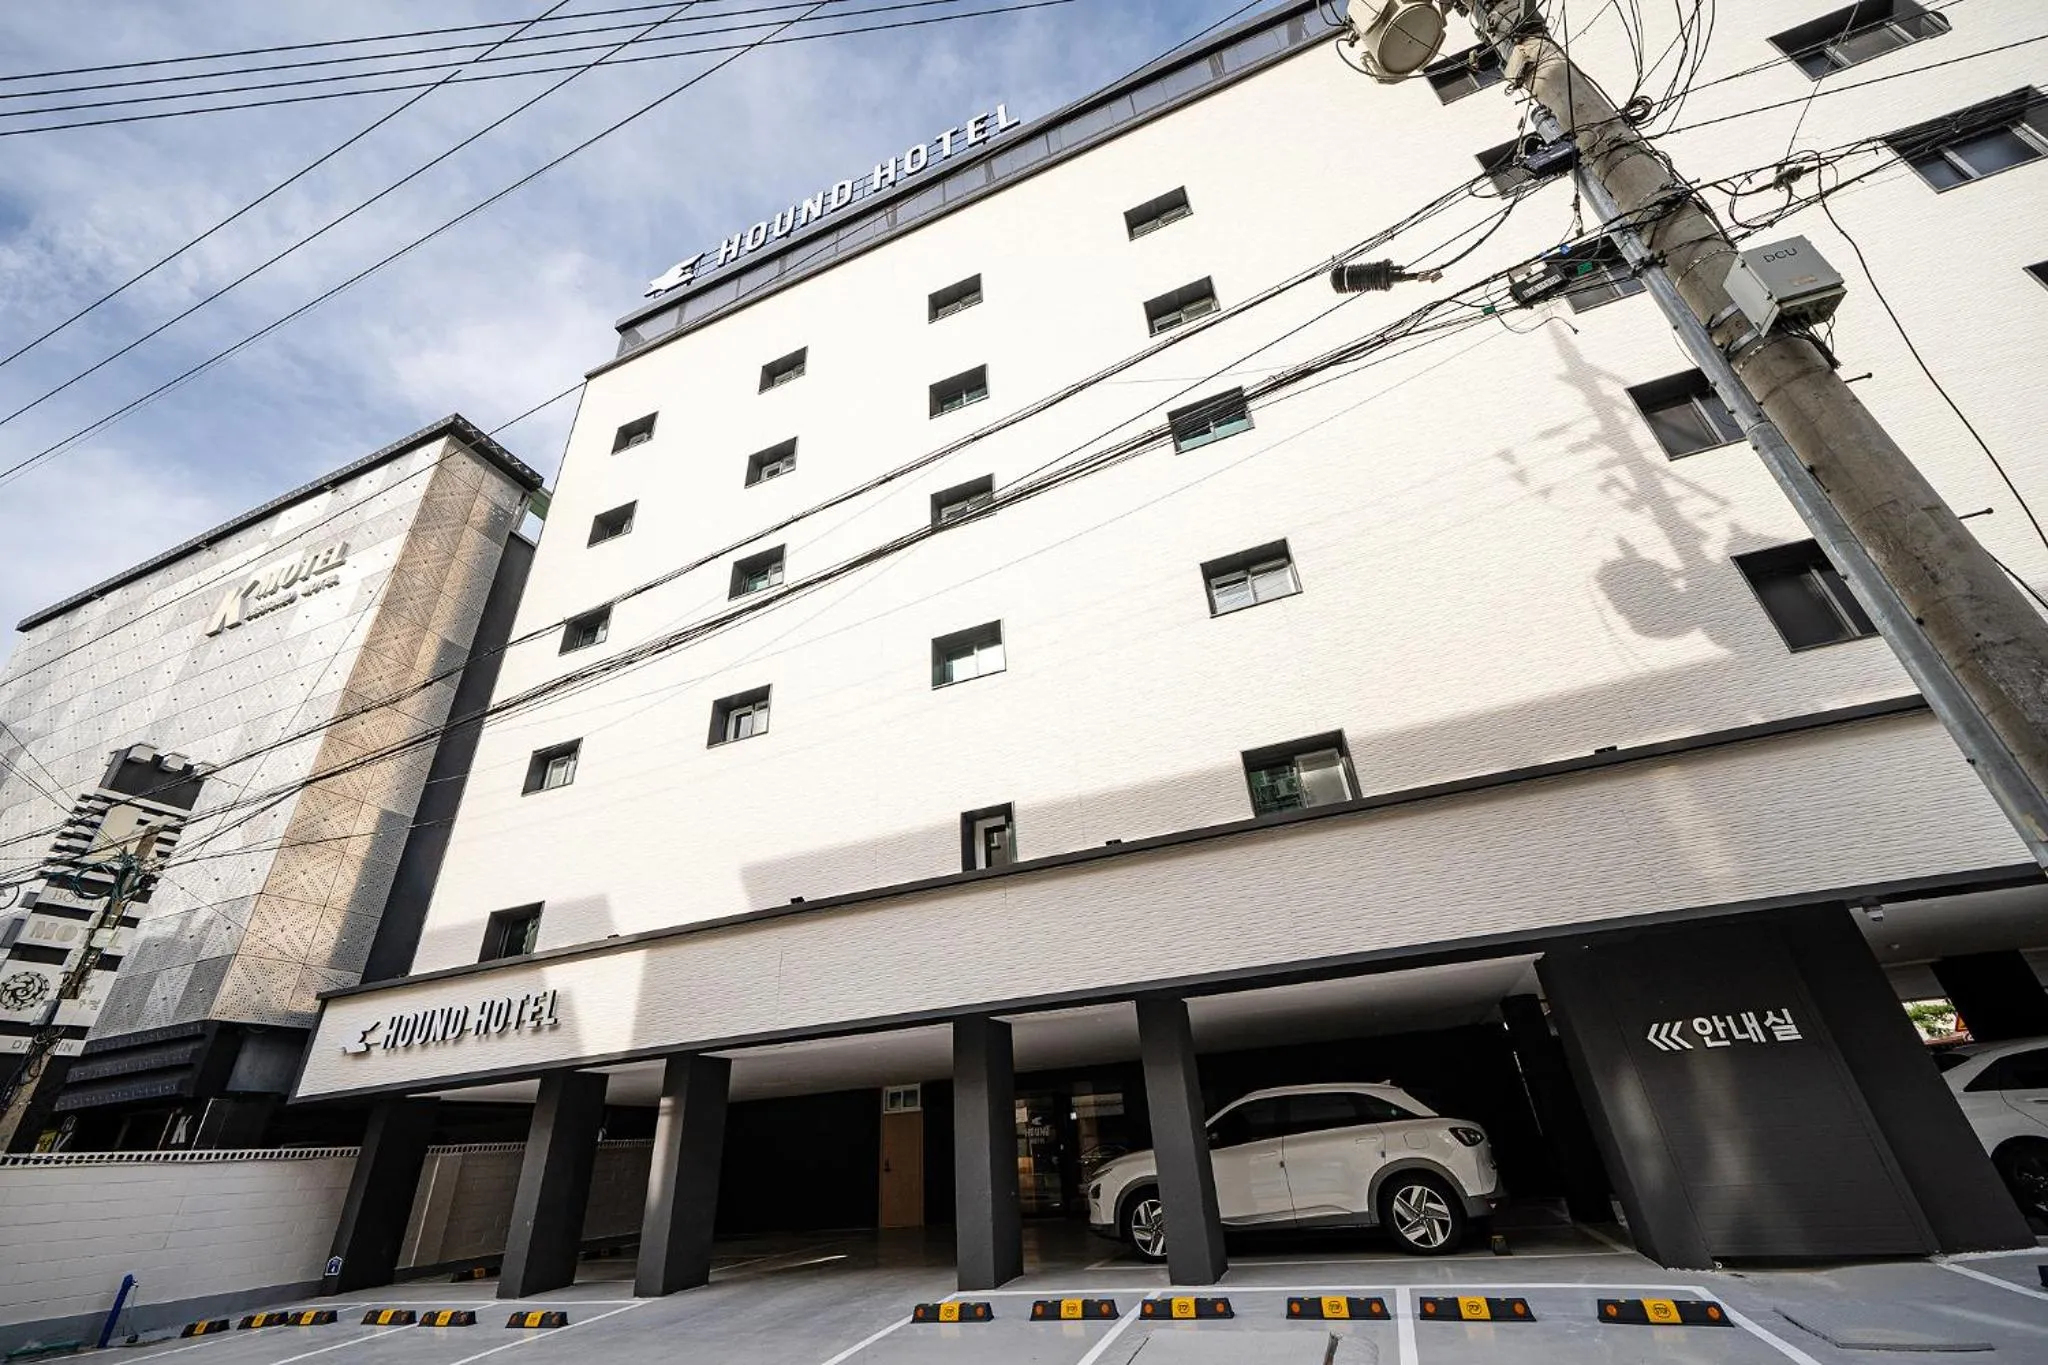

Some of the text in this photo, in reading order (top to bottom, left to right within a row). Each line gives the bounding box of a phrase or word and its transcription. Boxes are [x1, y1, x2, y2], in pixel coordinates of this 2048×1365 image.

[717, 103, 1021, 267] HOUND HOTEL
[1763, 247, 1798, 263] DCU
[382, 989, 559, 1050] HOUND HOTEL
[1692, 1008, 1803, 1048] 안내실
